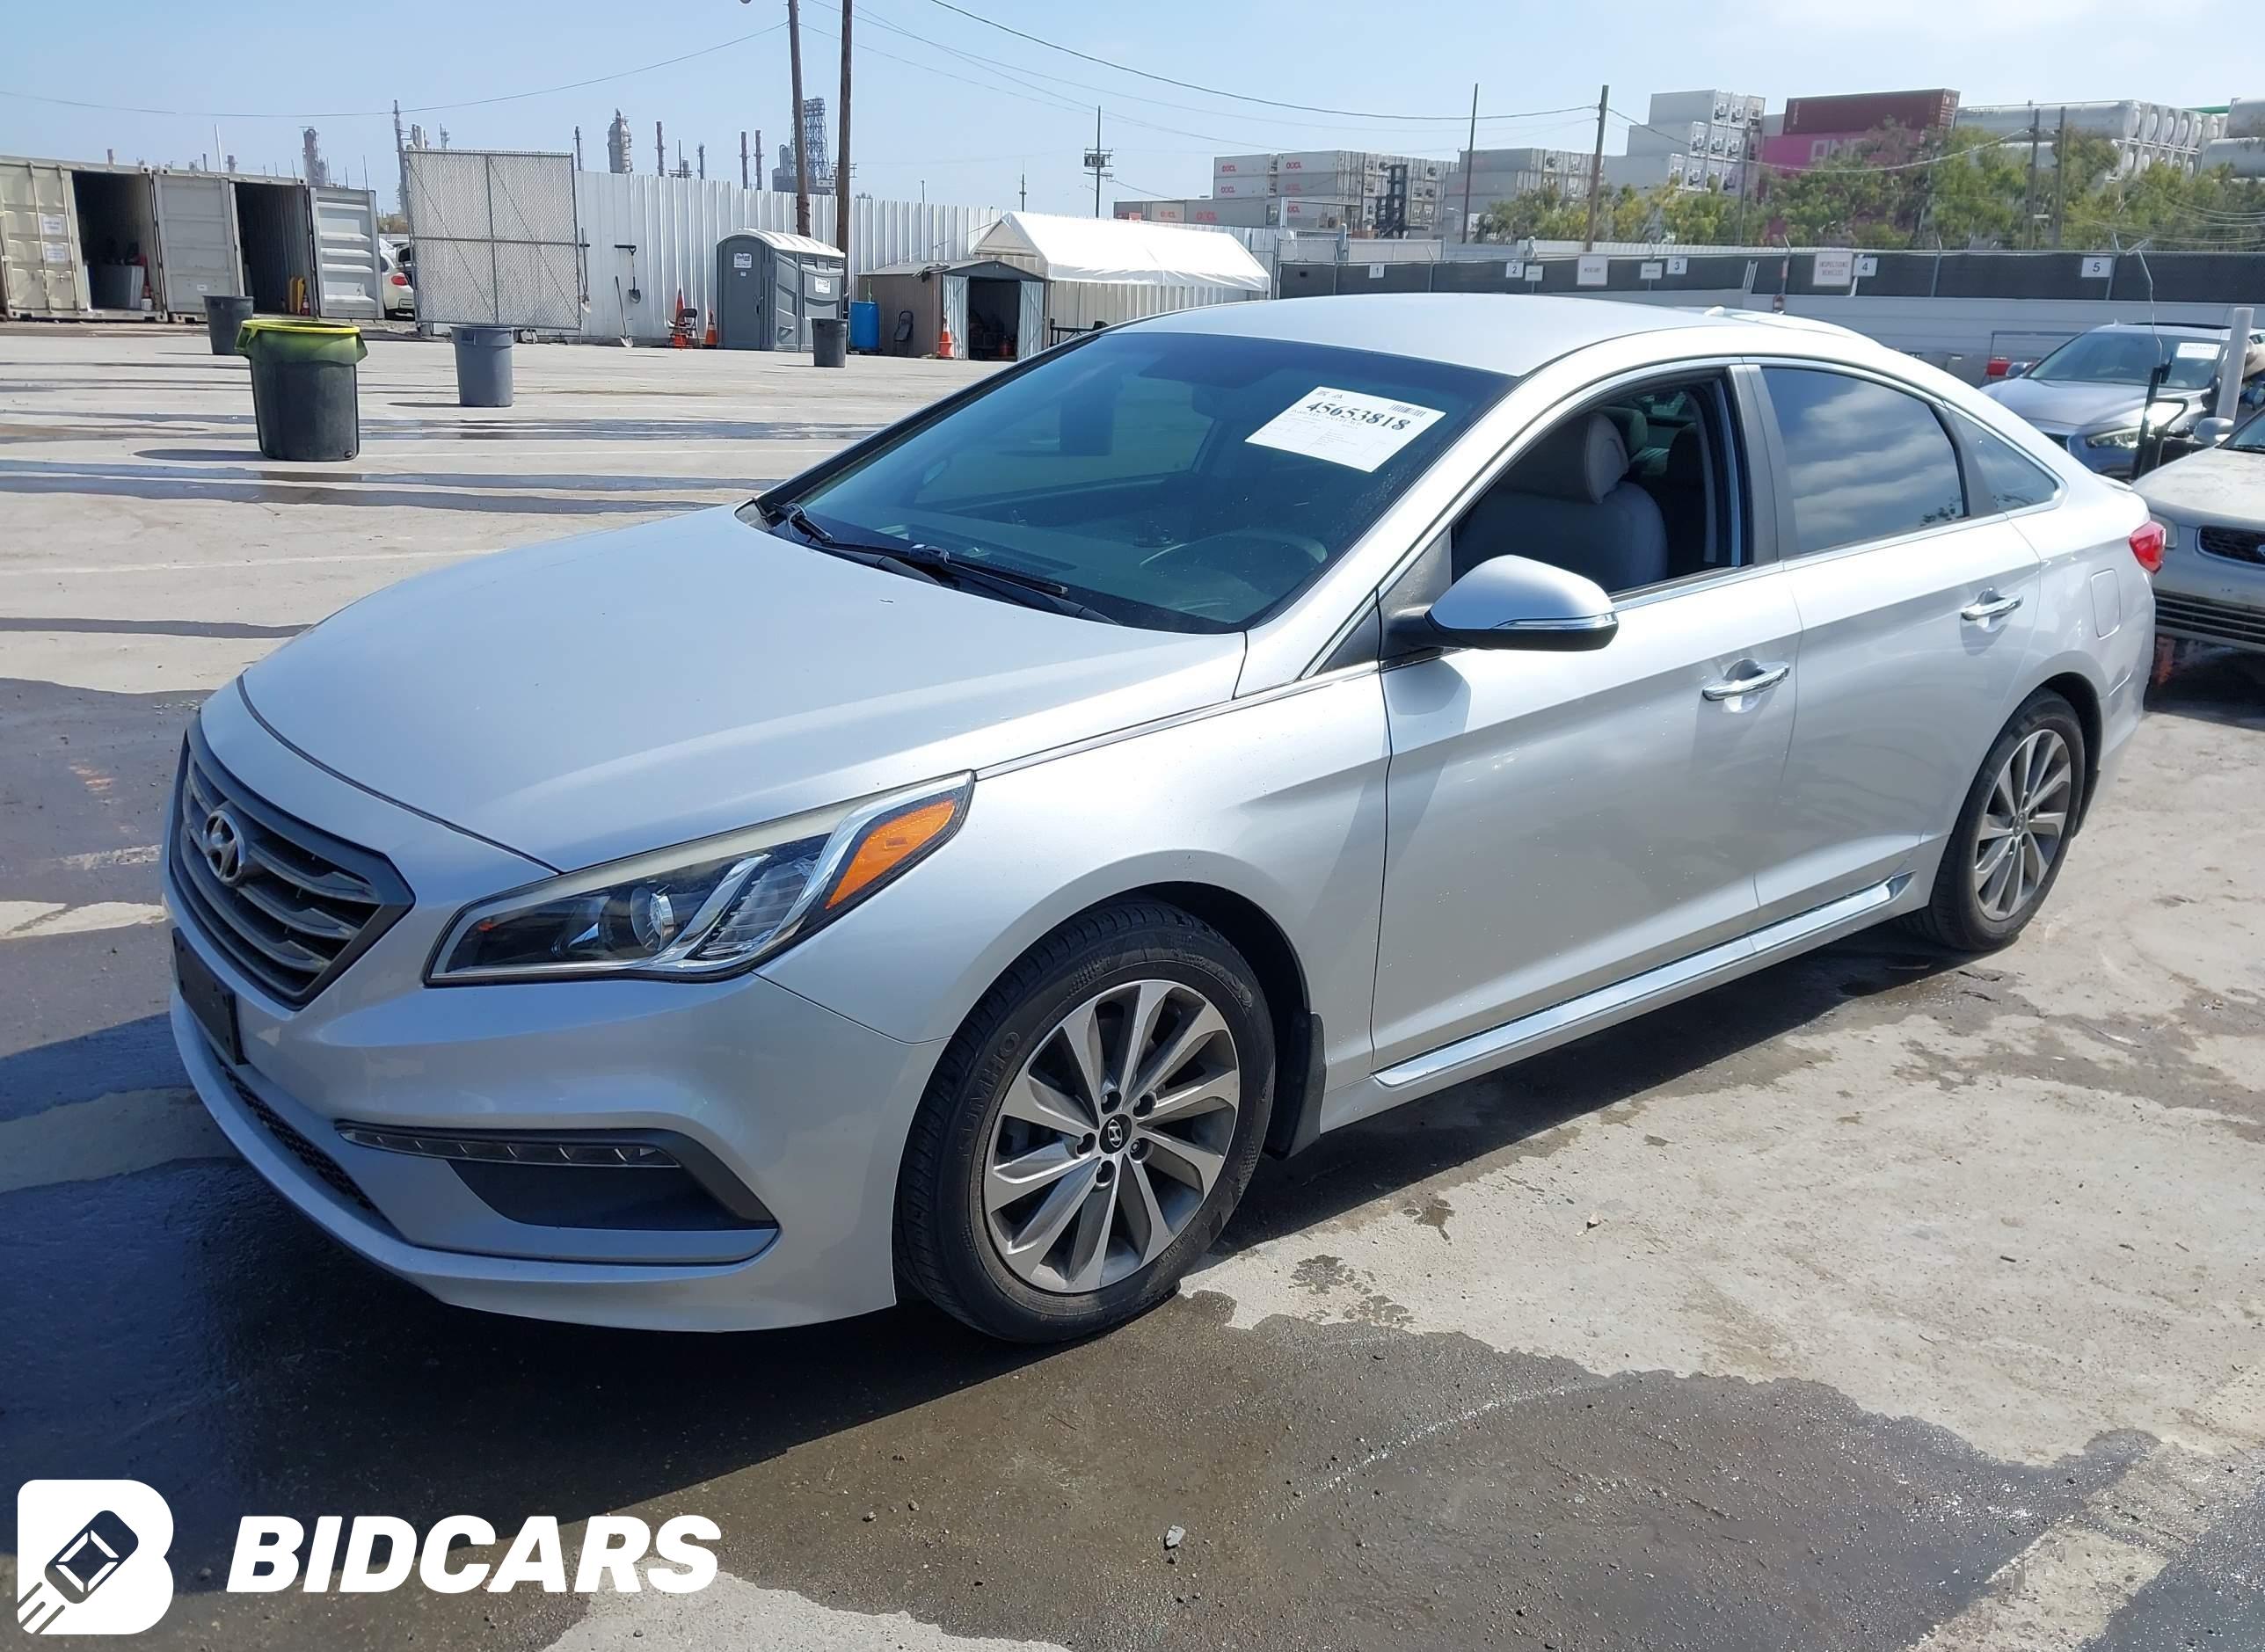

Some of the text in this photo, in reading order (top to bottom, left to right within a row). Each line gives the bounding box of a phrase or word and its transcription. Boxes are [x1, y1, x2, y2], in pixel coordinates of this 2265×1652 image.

[1674, 261, 1680, 271] 3
[1861, 262, 1868, 272] 4
[2092, 261, 2101, 273] 5
[1306, 401, 1411, 431] 45653818
